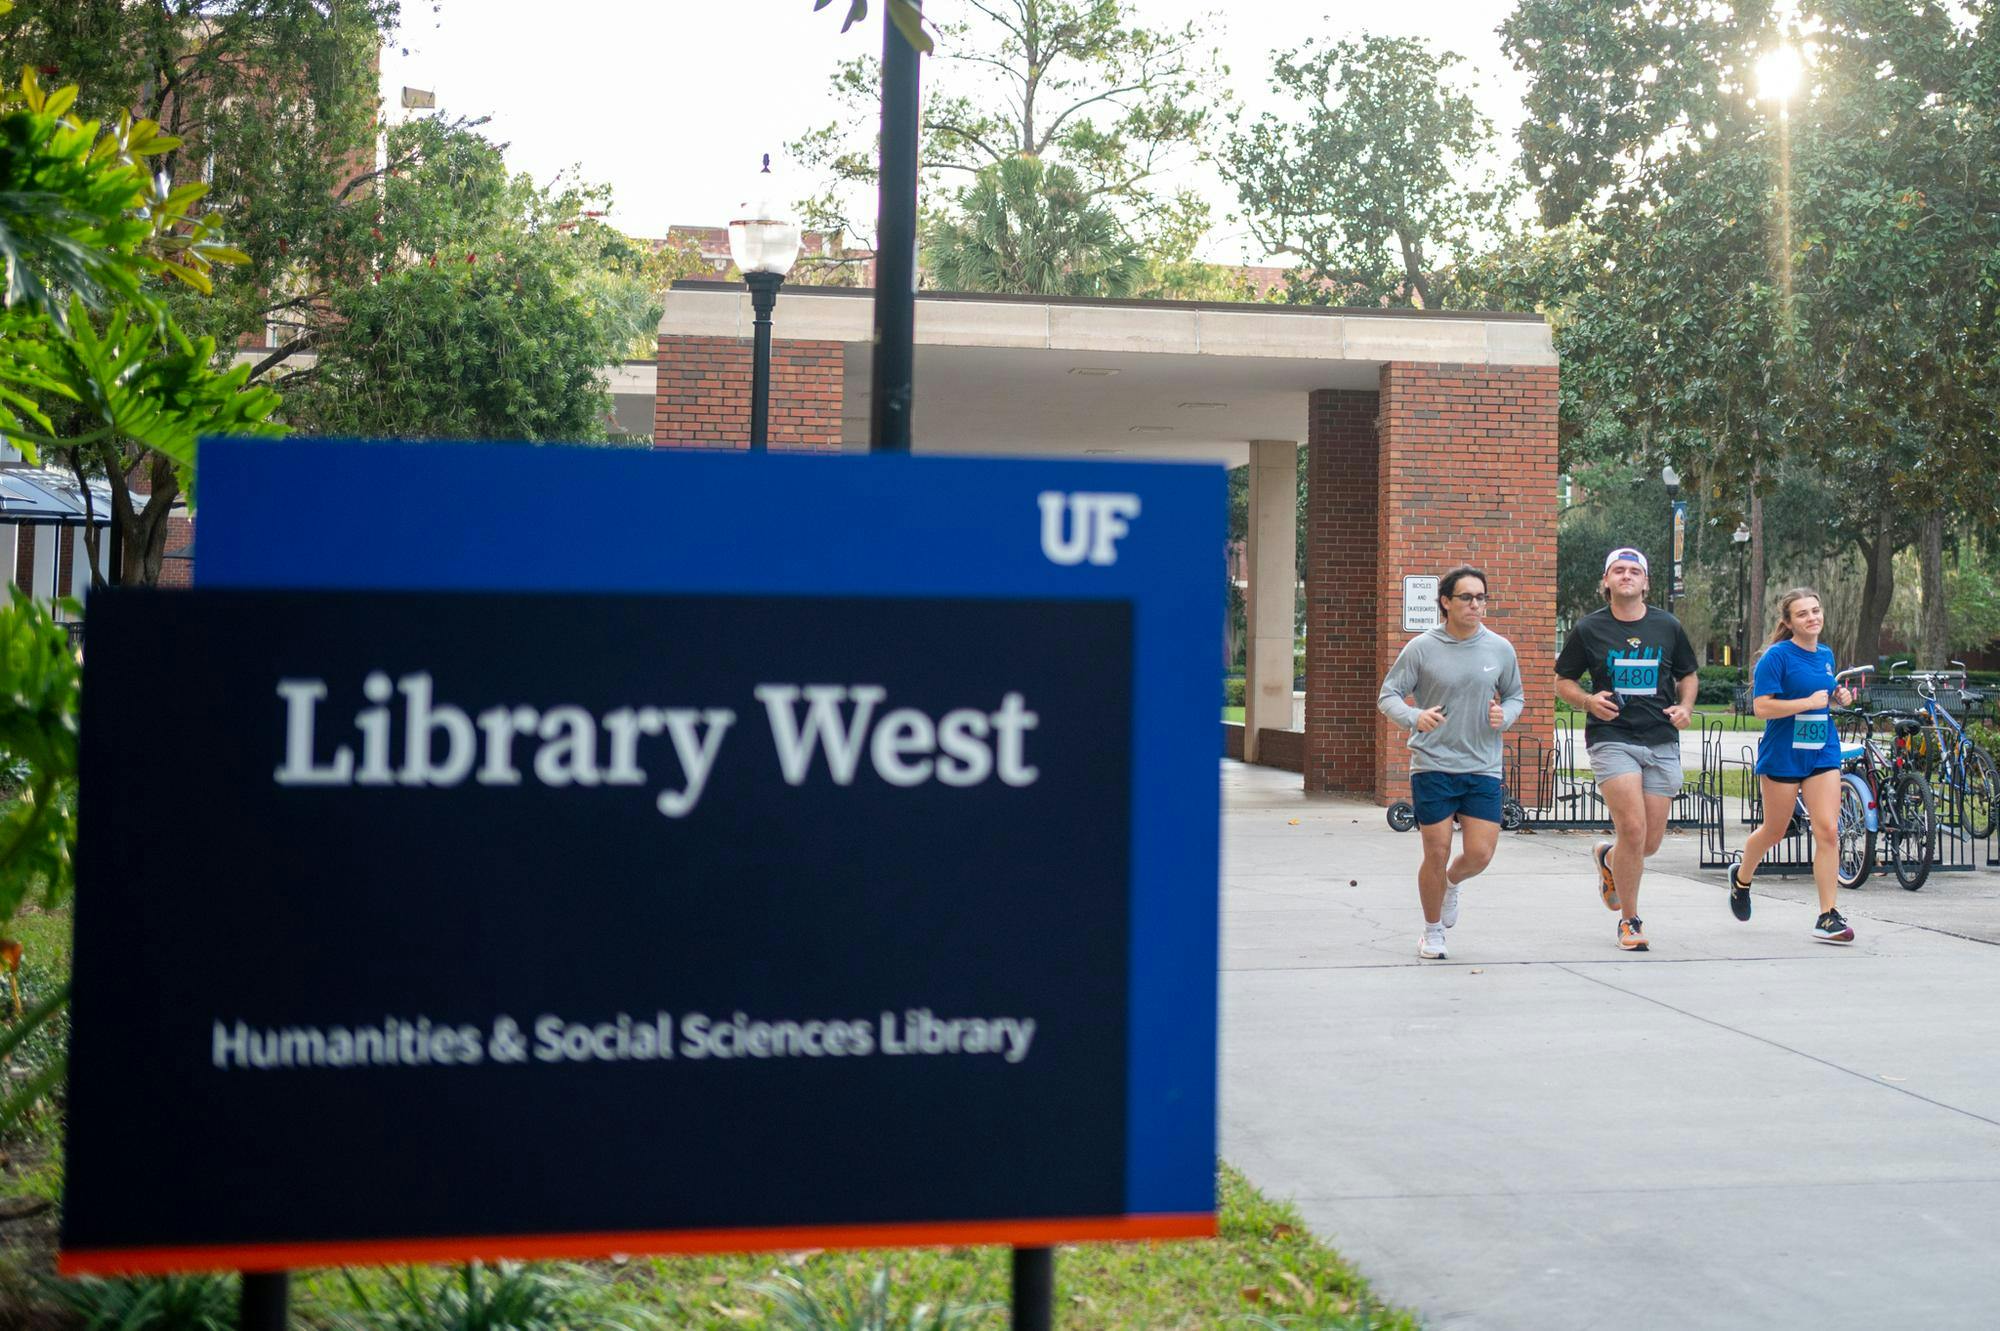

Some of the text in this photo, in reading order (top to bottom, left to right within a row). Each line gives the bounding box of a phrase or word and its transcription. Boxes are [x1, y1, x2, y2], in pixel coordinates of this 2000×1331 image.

[1039, 492, 1140, 565] UF
[1617, 668, 1655, 686] 480
[276, 670, 1039, 815] Library West
[1796, 723, 1826, 741] 493
[211, 1009, 1035, 1067] Humanities & Social Sciences Library
